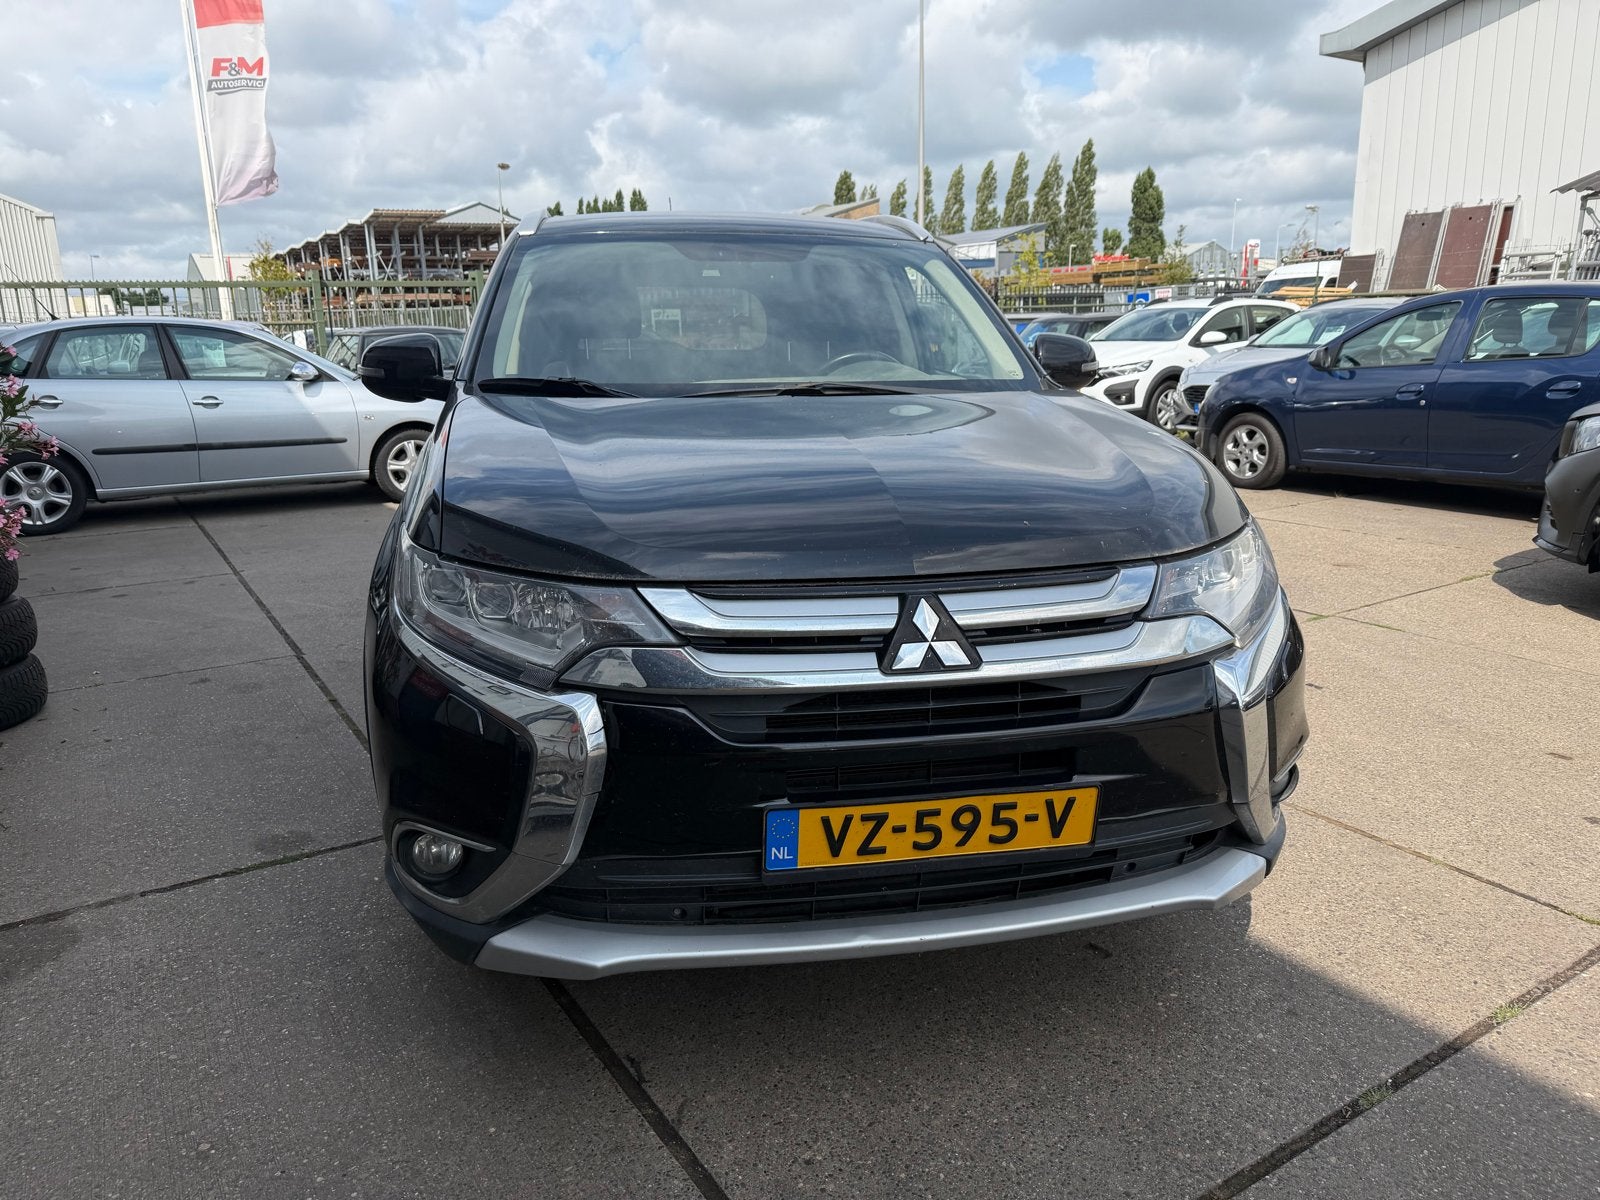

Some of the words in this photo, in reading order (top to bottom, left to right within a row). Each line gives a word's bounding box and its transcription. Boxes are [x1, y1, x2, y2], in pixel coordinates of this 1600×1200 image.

[211, 56, 264, 77] F&M
[820, 796, 1077, 858] VZ-595-V
[771, 846, 794, 860] NL
